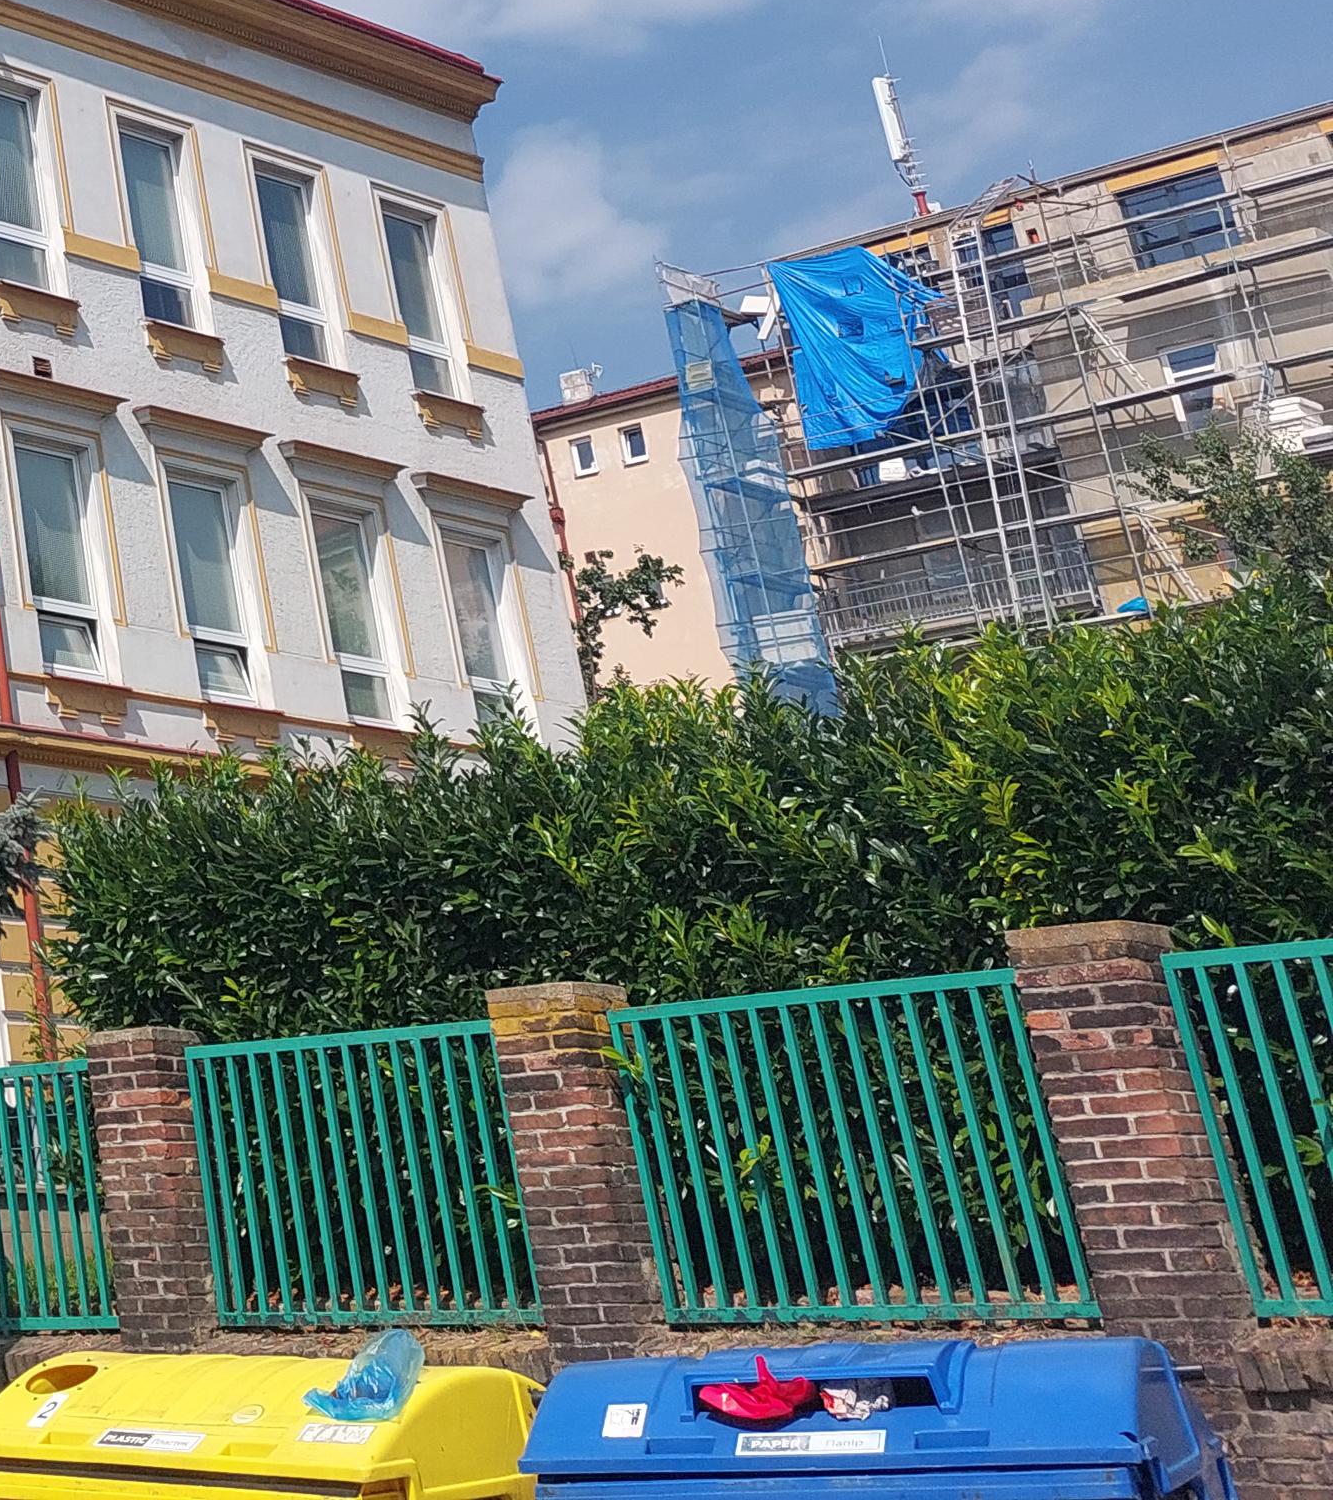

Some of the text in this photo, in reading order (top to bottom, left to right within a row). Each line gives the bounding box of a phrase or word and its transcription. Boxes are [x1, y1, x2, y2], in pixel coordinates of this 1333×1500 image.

[36, 1401, 58, 1419] 2
[103, 1434, 149, 1445] PLASTIC
[750, 1437, 800, 1449] PAPER
